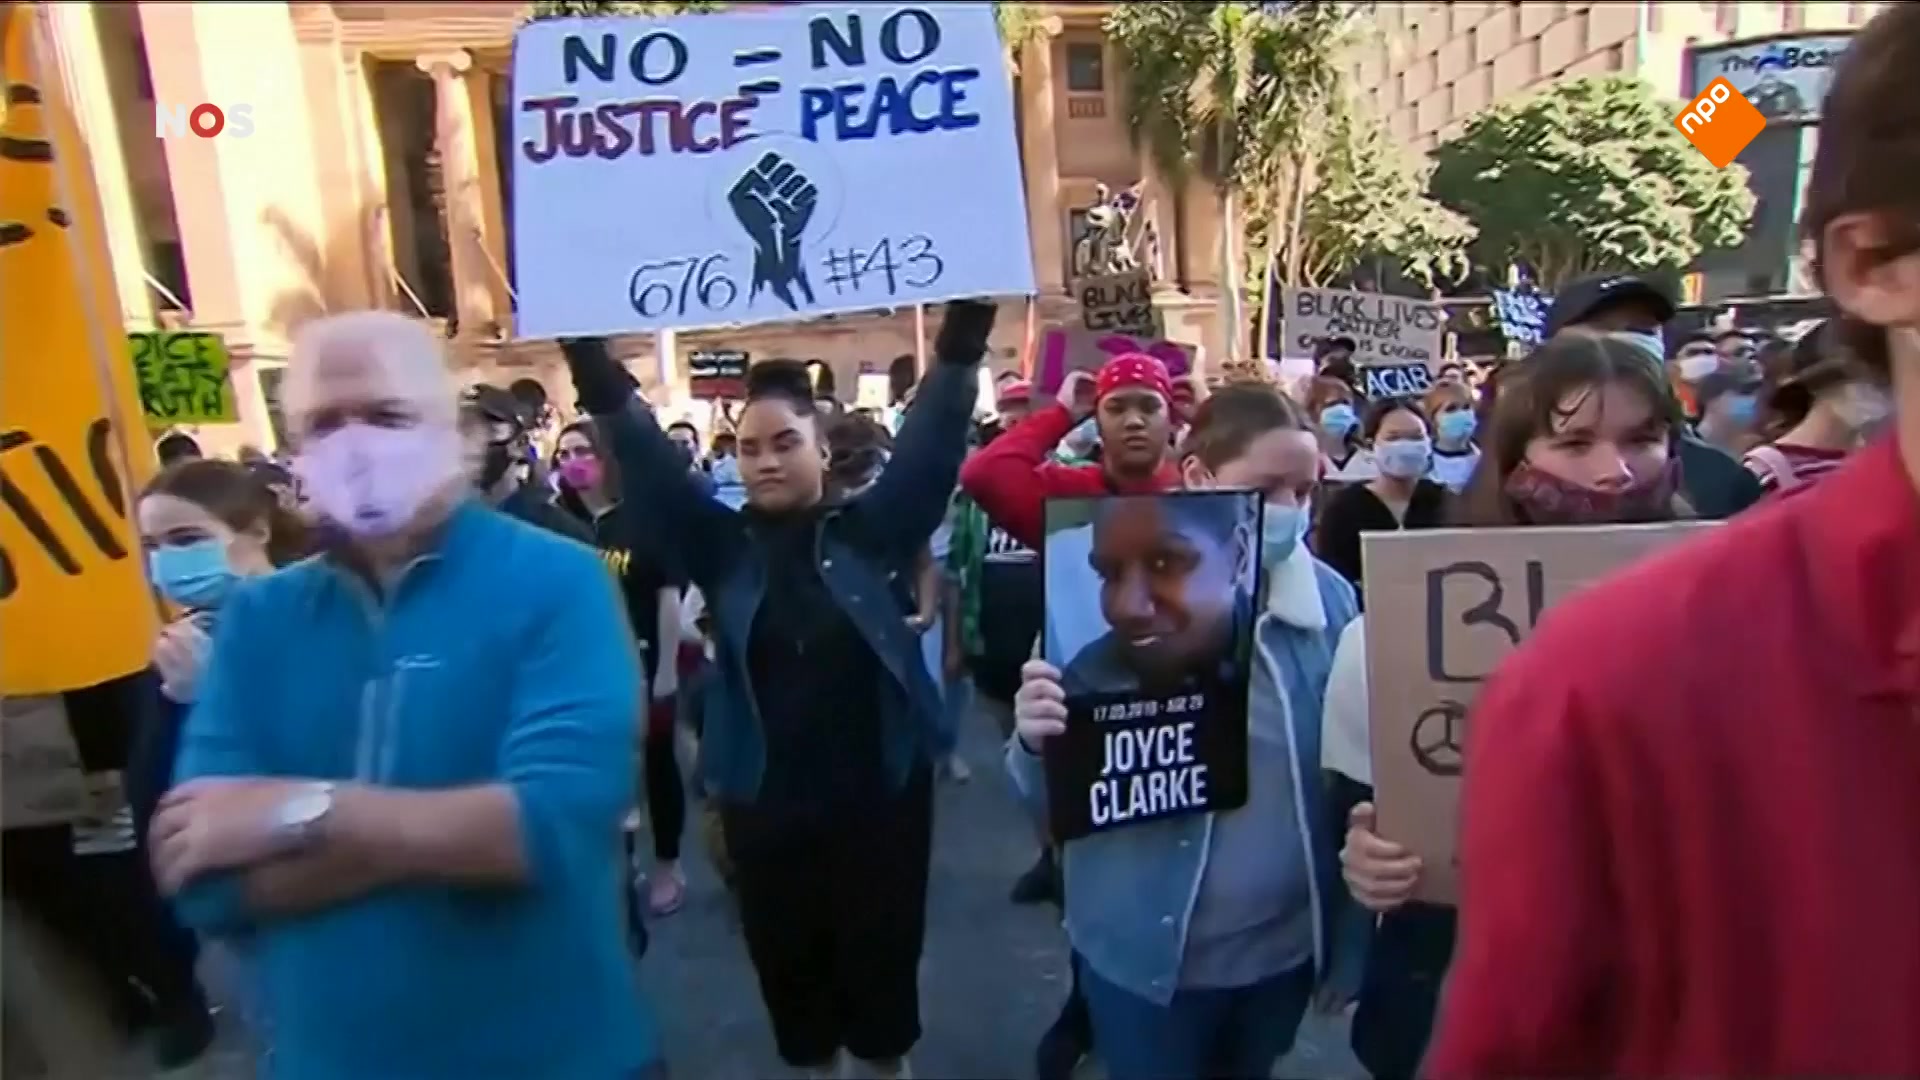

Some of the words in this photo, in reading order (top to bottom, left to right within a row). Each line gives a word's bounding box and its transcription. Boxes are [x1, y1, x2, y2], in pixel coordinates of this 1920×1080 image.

[563, 31, 689, 84] NO
[809, 8, 942, 68] NO
[522, 97, 763, 164] JUSTICE
[800, 68, 981, 142] PEACE
[629, 254, 738, 319] 676
[822, 234, 944, 296] #43
[1297, 292, 1366, 323] BLACK
[1376, 299, 1440, 330] LIVES
[1100, 721, 1195, 775] JOYCE
[1089, 764, 1208, 826] CLARKE
